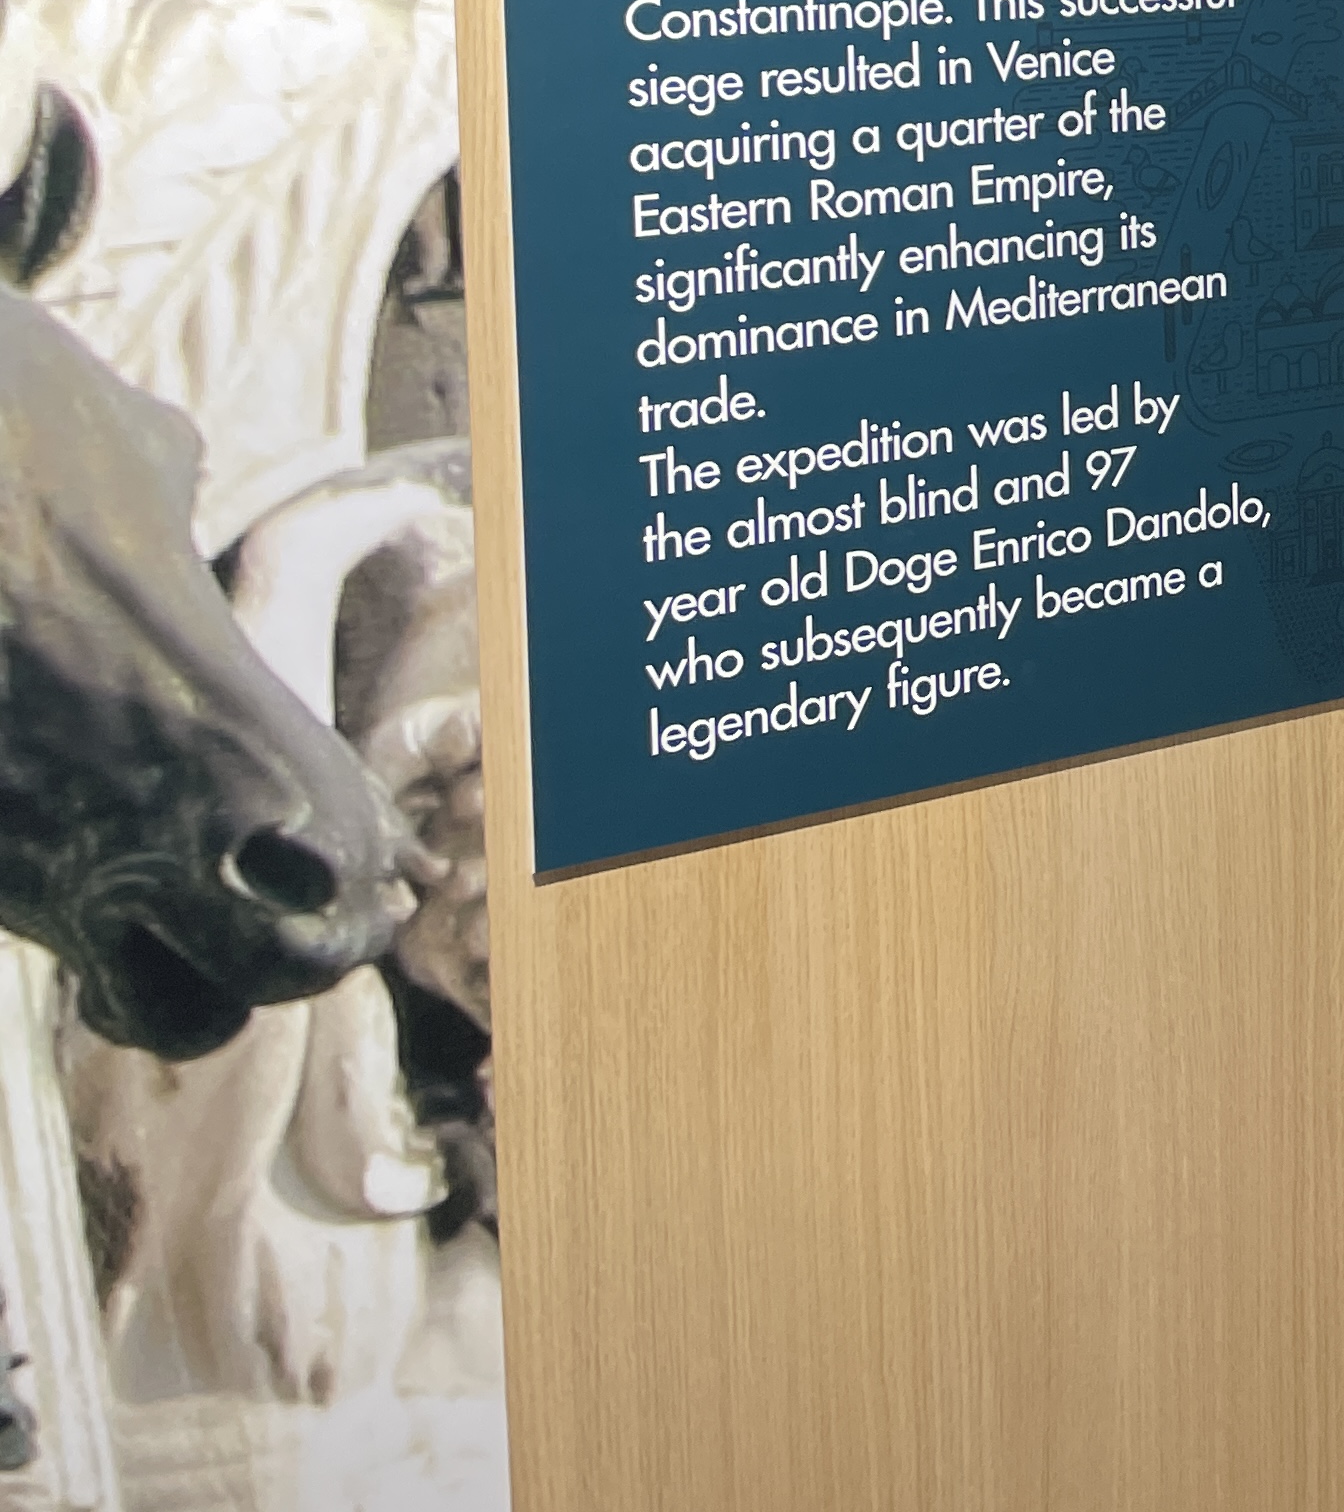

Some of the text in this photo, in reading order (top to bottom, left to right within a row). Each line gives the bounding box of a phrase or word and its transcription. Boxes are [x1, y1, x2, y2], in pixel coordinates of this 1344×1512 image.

[629, 38, 1115, 116] siege resulted in Venice
[630, 88, 1166, 180] acquiring a quarter of the
[634, 158, 1113, 237] Eastern Roman Empire,
[636, 212, 1156, 312] significantly enhancing its
[637, 273, 1226, 367] dominance in Mediterranean
[639, 374, 766, 432] trade.
[639, 381, 1180, 496] The expedition was led by
[643, 446, 1137, 562] the almost blind and 97
[643, 482, 1271, 642] year old Doge Enrico Dandolo,
[645, 561, 1222, 690] who subsequently became a
[651, 661, 1010, 760] legendary figure.
